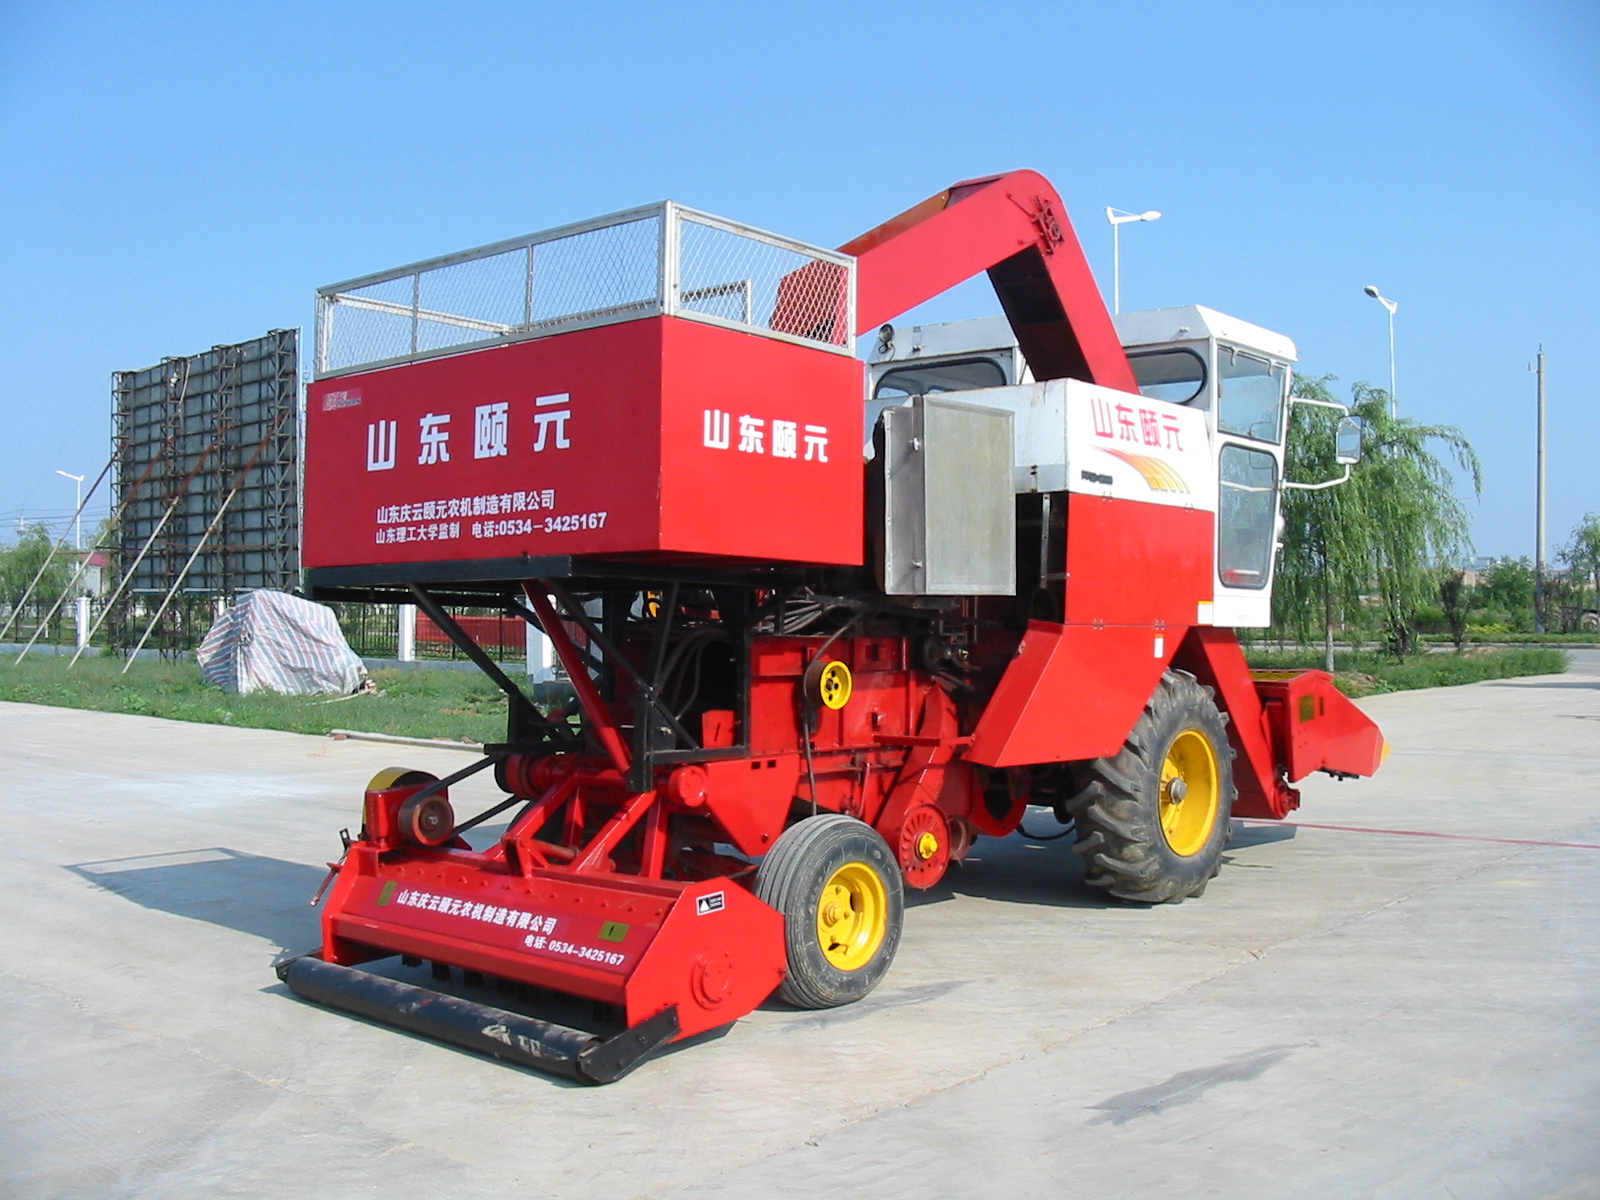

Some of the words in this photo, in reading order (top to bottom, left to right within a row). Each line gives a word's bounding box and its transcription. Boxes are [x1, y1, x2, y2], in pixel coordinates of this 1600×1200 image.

[366, 393, 571, 471] 山东颐元
[703, 409, 829, 462] 山东颐元
[1090, 398, 1184, 452] 山东颐元
[376, 489, 555, 524] 山东庆云颐元农机制造有限公司
[375, 522, 460, 544] 山东理工大学监制
[396, 888, 558, 935] 山东庆云颐元农机制造有限公司
